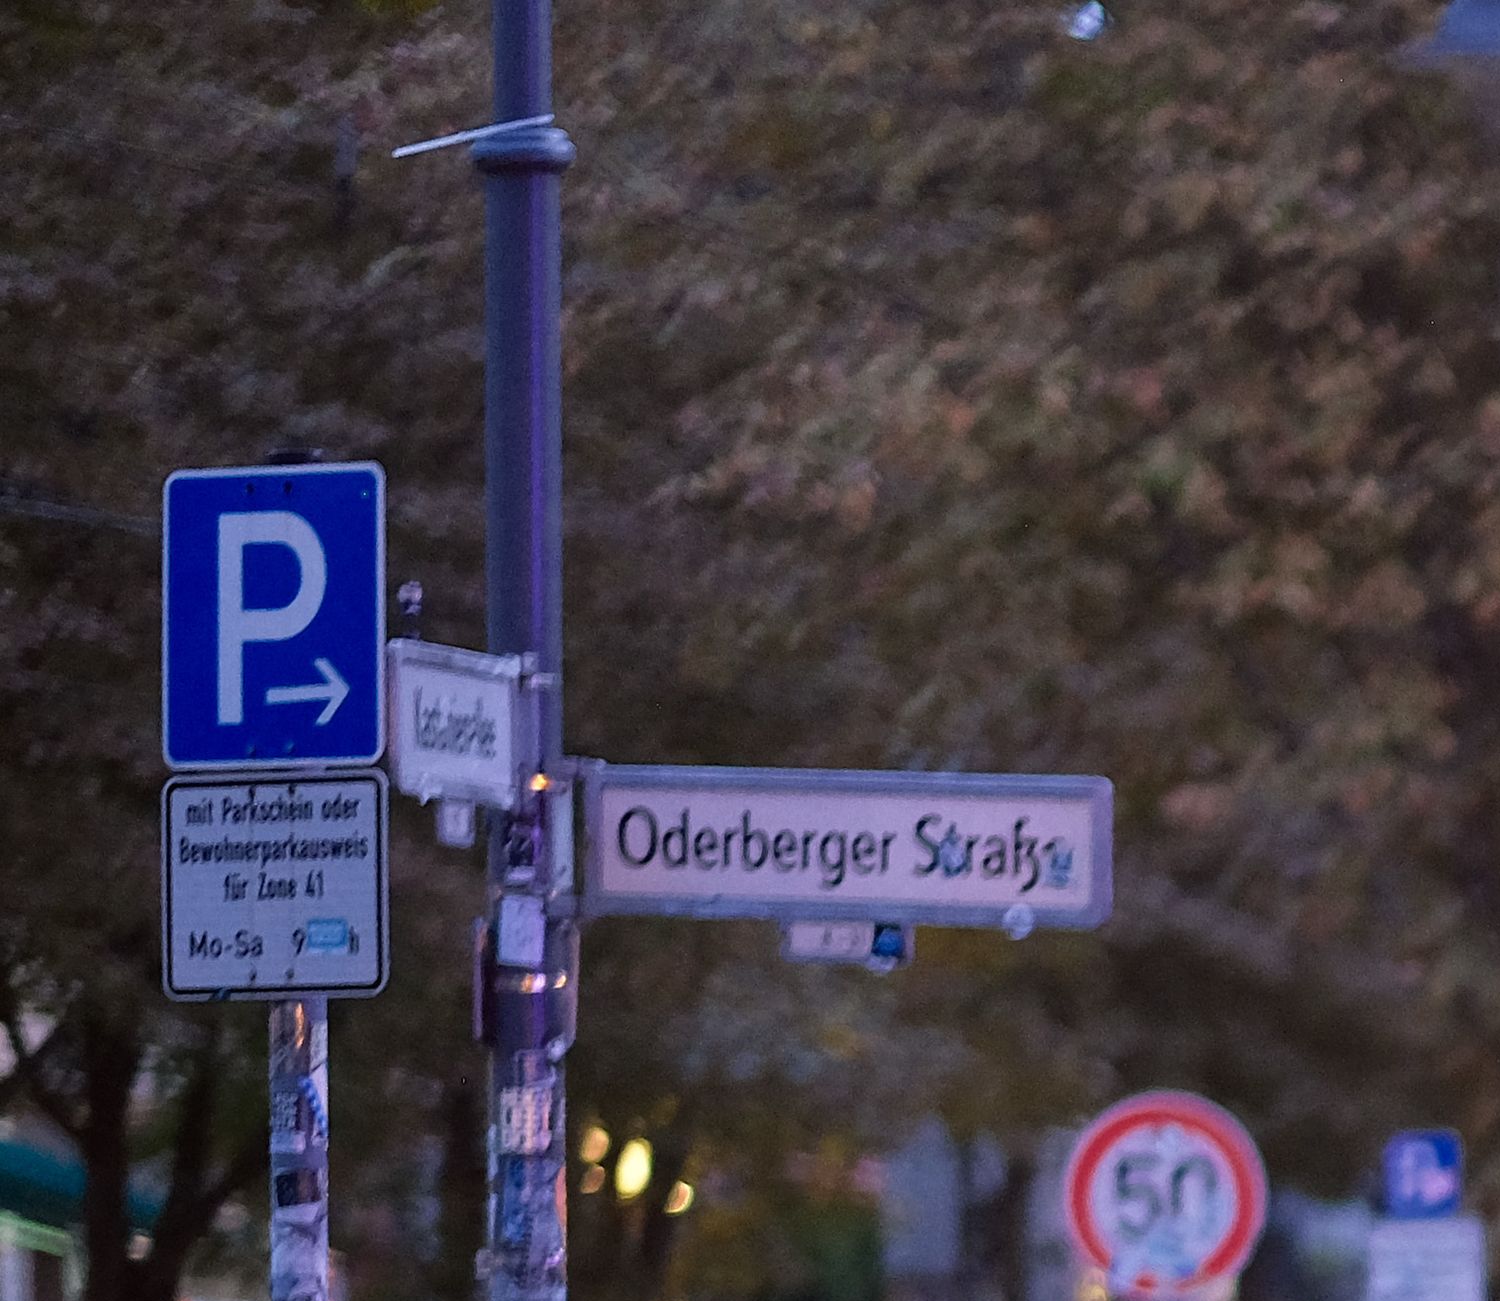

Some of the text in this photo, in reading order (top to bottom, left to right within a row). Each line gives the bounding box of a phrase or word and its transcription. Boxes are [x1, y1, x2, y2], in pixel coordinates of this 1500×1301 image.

[217, 510, 327, 726] P
[186, 791, 360, 826] mit Parkschein oder
[179, 830, 369, 867] Bewohnerparkausweis
[617, 805, 897, 890] Oderberger
[223, 869, 324, 902] für Zone 41
[188, 928, 263, 959] Mo-Sa
[1114, 1150, 1220, 1242] 50
